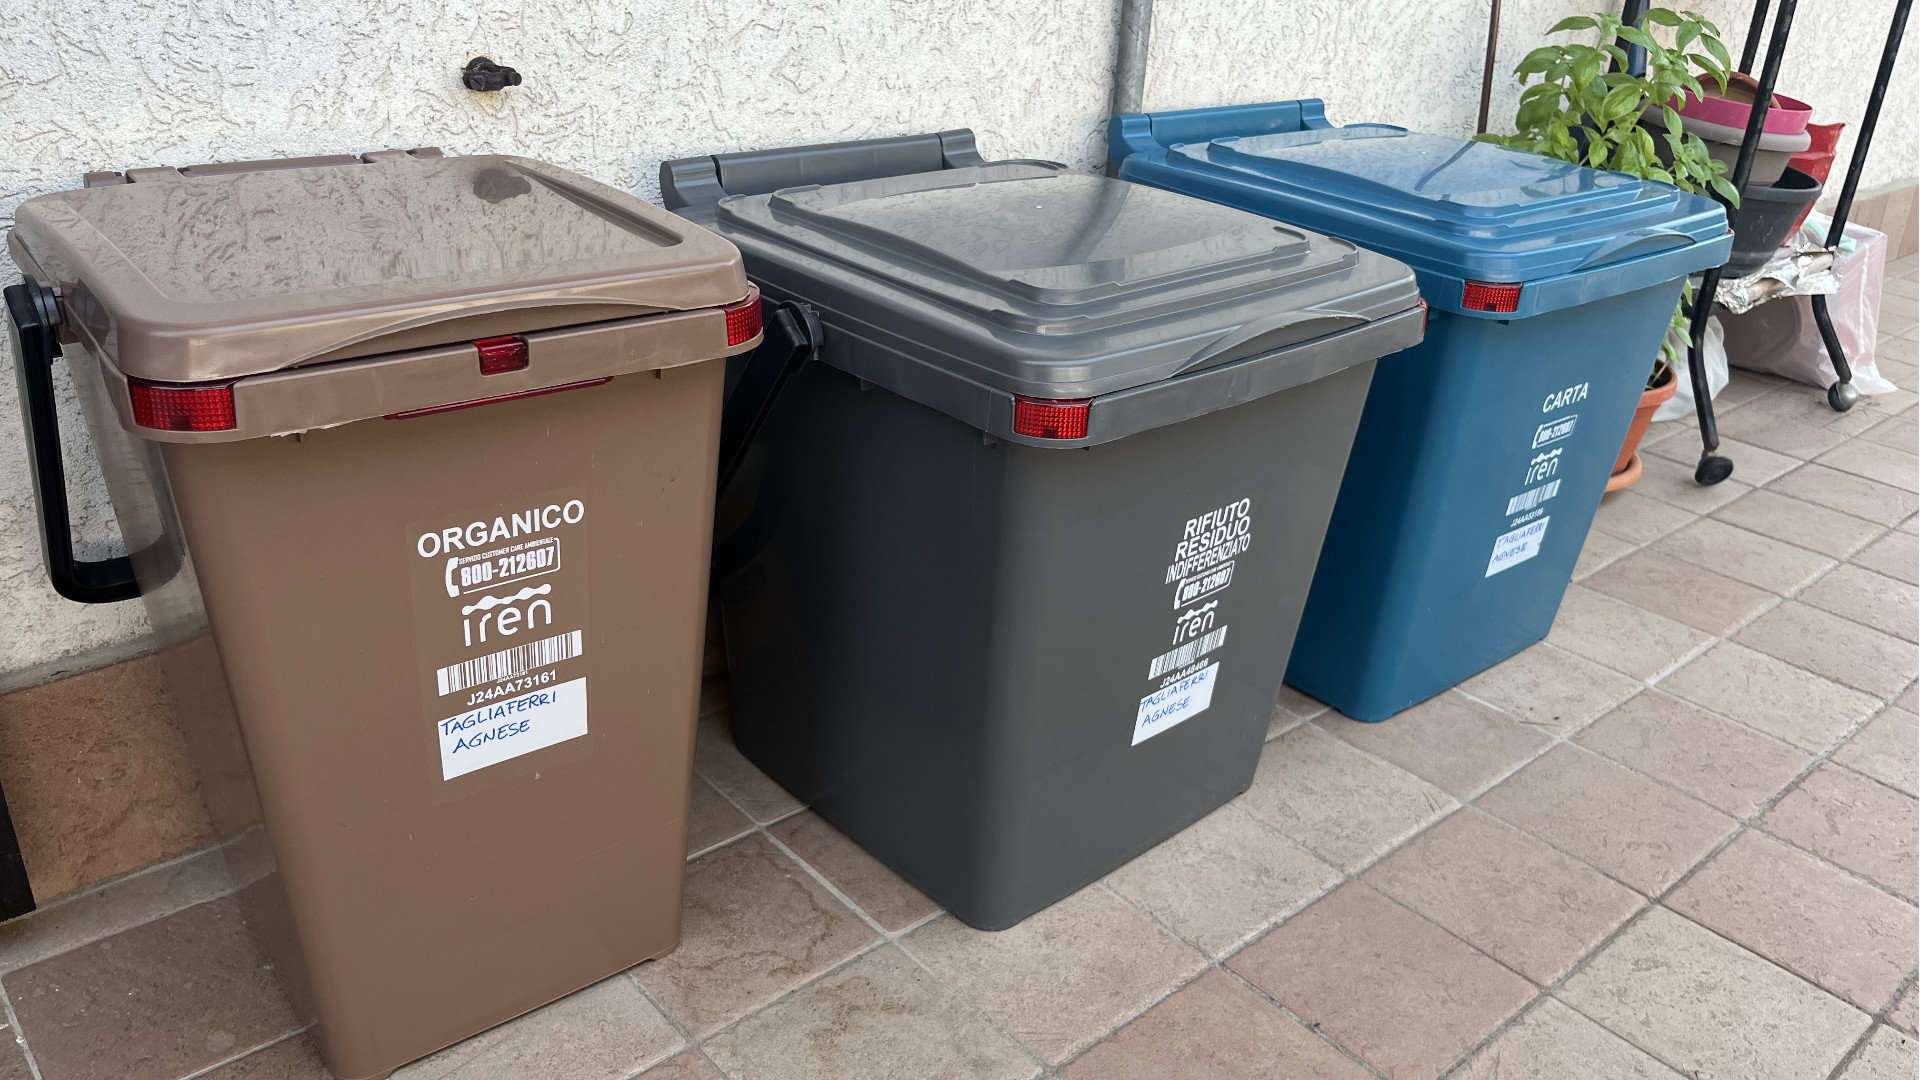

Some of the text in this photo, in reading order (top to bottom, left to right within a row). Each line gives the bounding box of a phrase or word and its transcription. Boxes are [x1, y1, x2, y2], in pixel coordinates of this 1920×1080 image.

[1543, 382, 1589, 413] CARTA
[1524, 457, 1559, 486] iren
[417, 500, 585, 558] ORGANICO
[1184, 498, 1250, 540] RIFIUTO
[459, 536, 554, 565] SERVIZIO CUSTOMER CARE AMBIENTALE
[1165, 533, 1250, 584] INDIFFERENZIATO
[1175, 516, 1250, 562] RESIDUO
[461, 546, 555, 587] 800-212607
[463, 600, 552, 646] iren
[1173, 610, 1215, 645] iren
[467, 669, 557, 706] J24AA73161
[440, 691, 556, 735] TAGLIAFERRI
[1142, 696, 1191, 727] AGNESE
[452, 719, 530, 754] AGNESE
